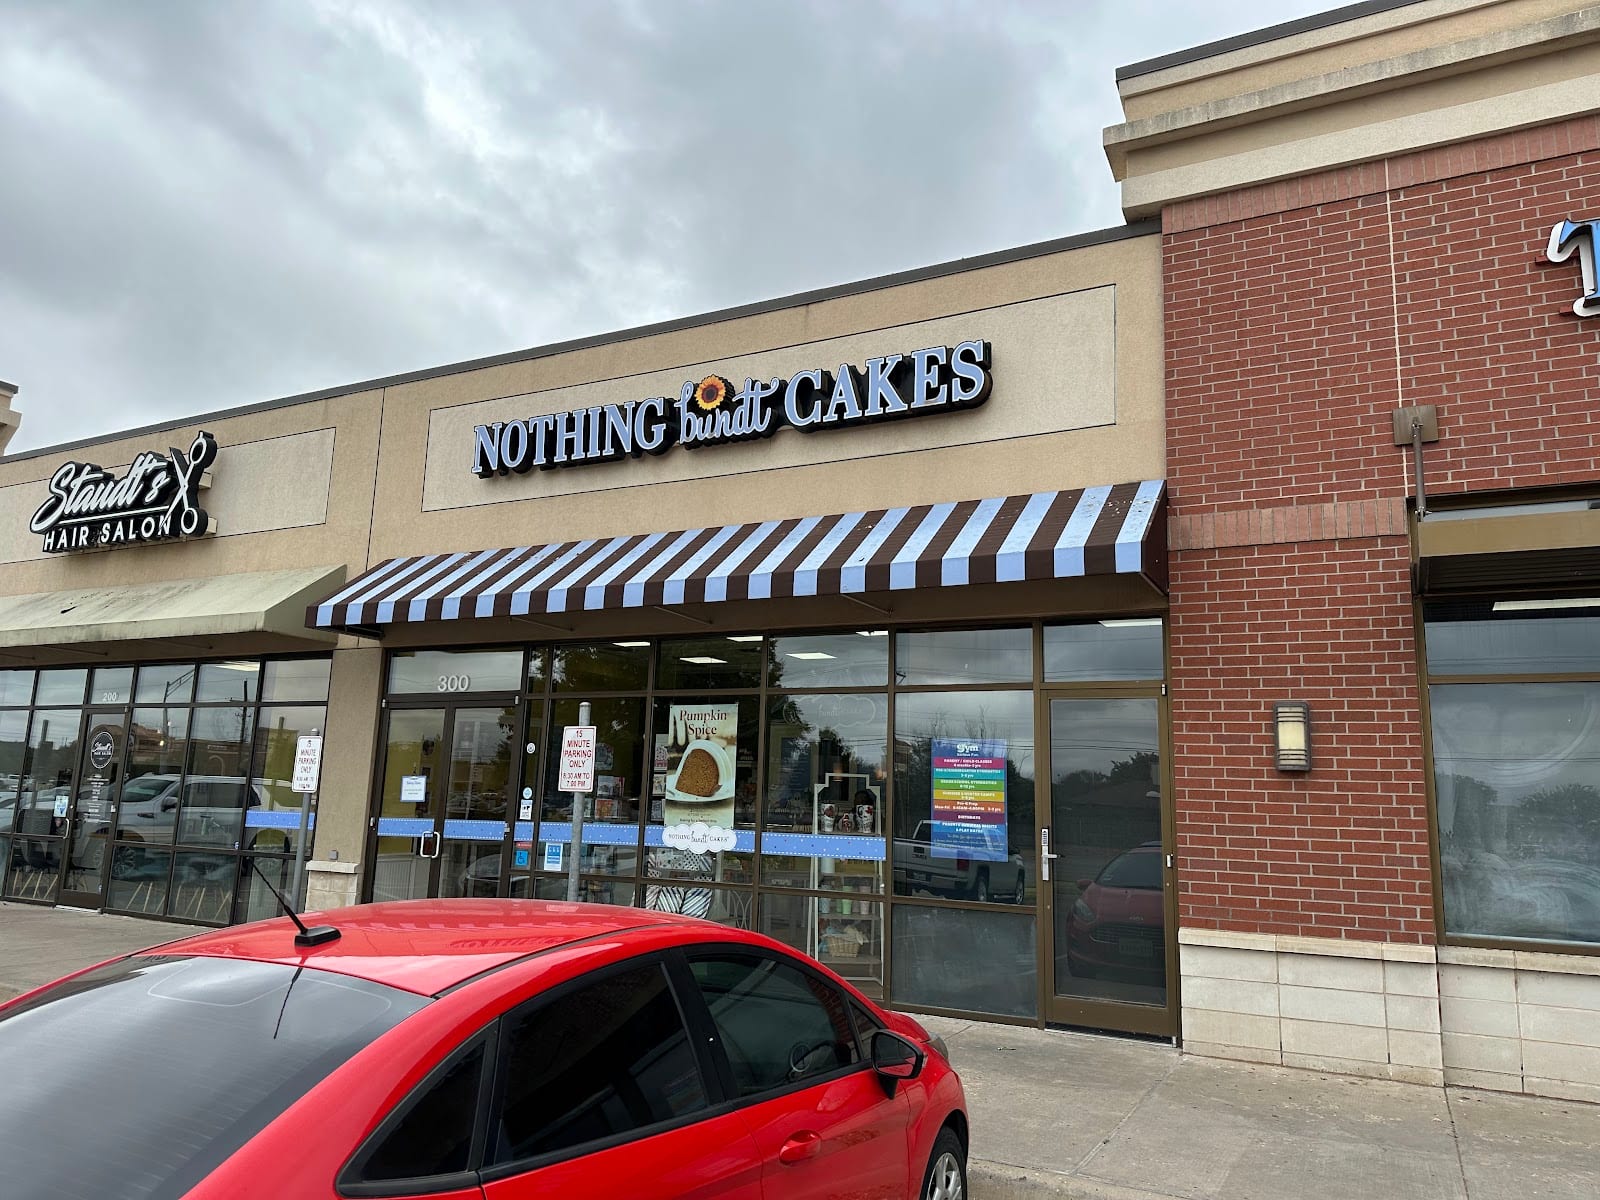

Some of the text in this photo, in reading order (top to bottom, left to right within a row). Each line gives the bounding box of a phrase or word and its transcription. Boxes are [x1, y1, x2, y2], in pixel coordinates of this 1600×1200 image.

[471, 339, 987, 474] NOTHING bundt CAKES
[30, 452, 171, 532] Staudt's
[43, 513, 172, 551] HAIR SALON
[437, 675, 470, 692] 300
[102, 692, 118, 702] 200
[680, 709, 728, 724] Pumpkin
[576, 730, 583, 738] 15
[688, 723, 718, 740] Spice
[567, 739, 591, 748] MINUTE
[957, 743, 979, 753] gym
[563, 749, 592, 758] PARKING
[569, 759, 586, 768] ONLY
[573, 772, 582, 780] AM
[583, 772, 591, 780] TO
